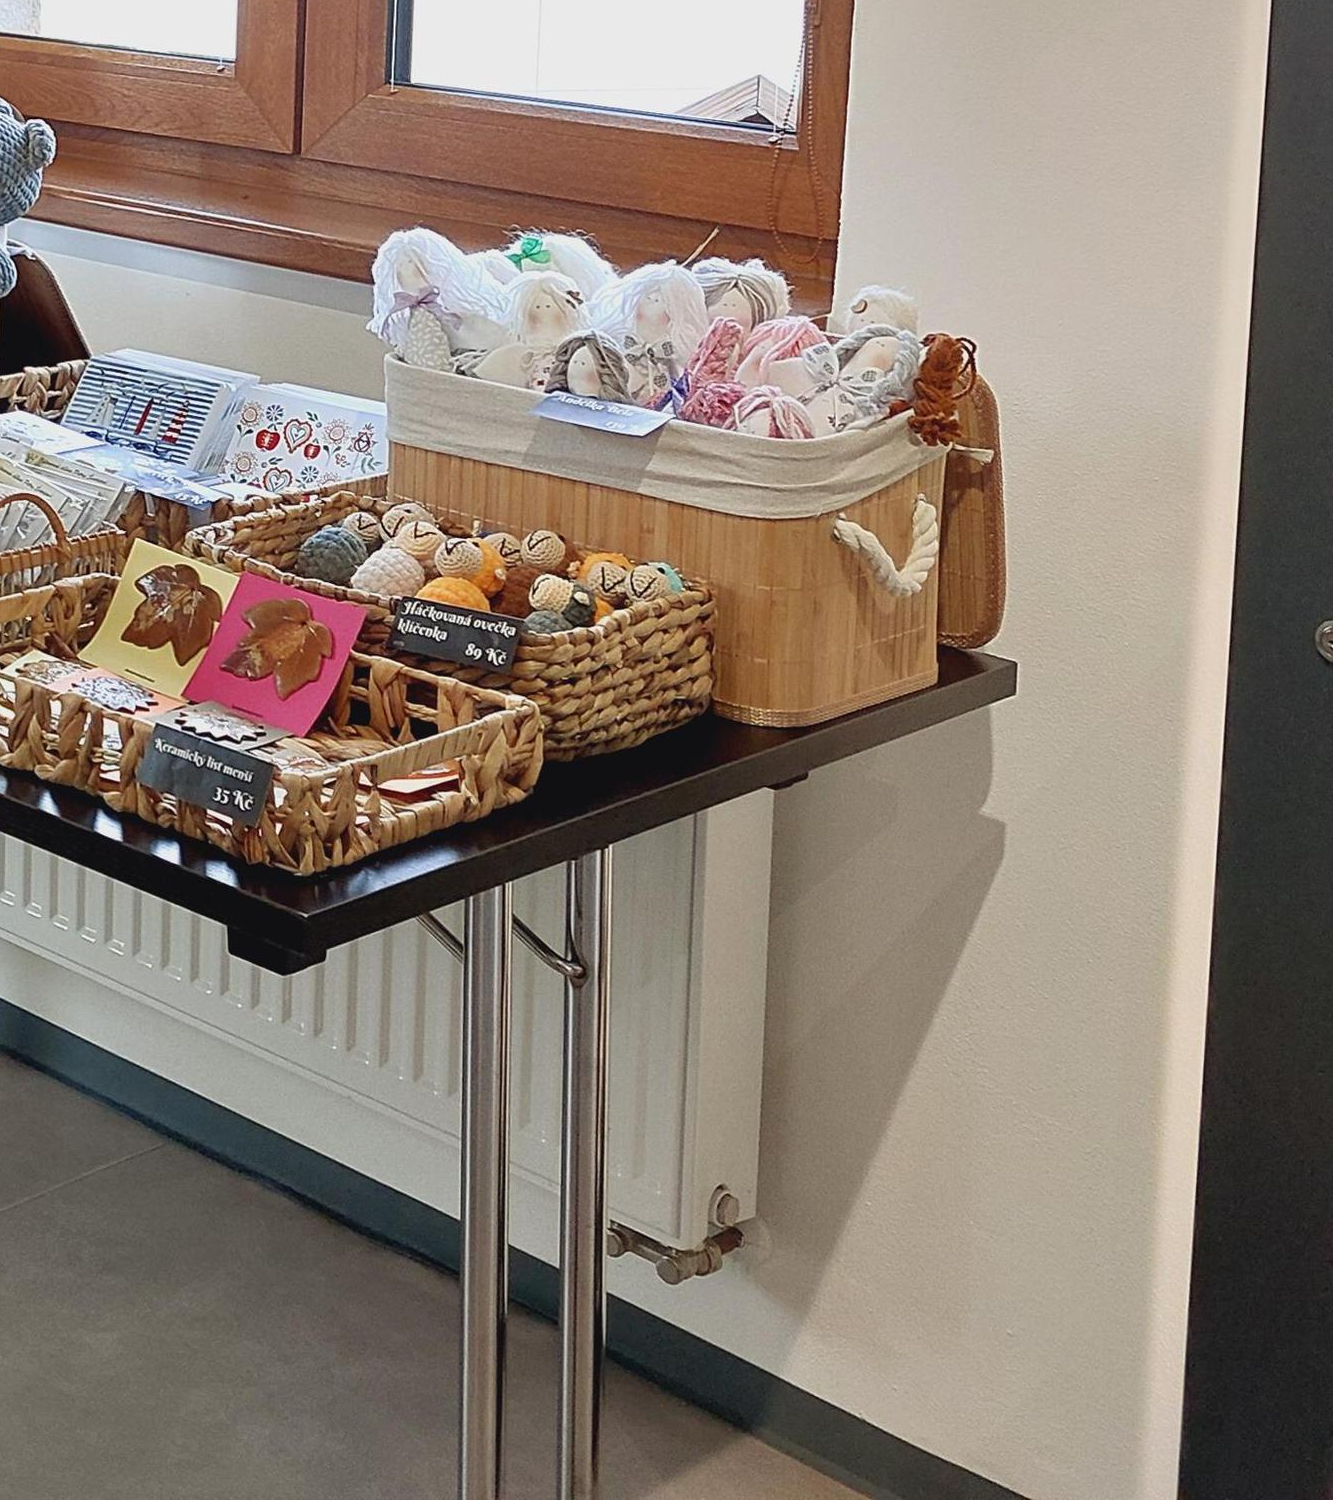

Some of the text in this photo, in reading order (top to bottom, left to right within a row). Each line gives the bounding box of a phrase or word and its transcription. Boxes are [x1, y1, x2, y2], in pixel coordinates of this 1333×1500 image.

[396, 617, 449, 642] klíčenka
[401, 599, 517, 639] Háčkovaná ovečka
[464, 642, 508, 666] 89 Kč
[154, 737, 254, 783] Keramický list menší
[213, 786, 254, 811] 35 Kč
